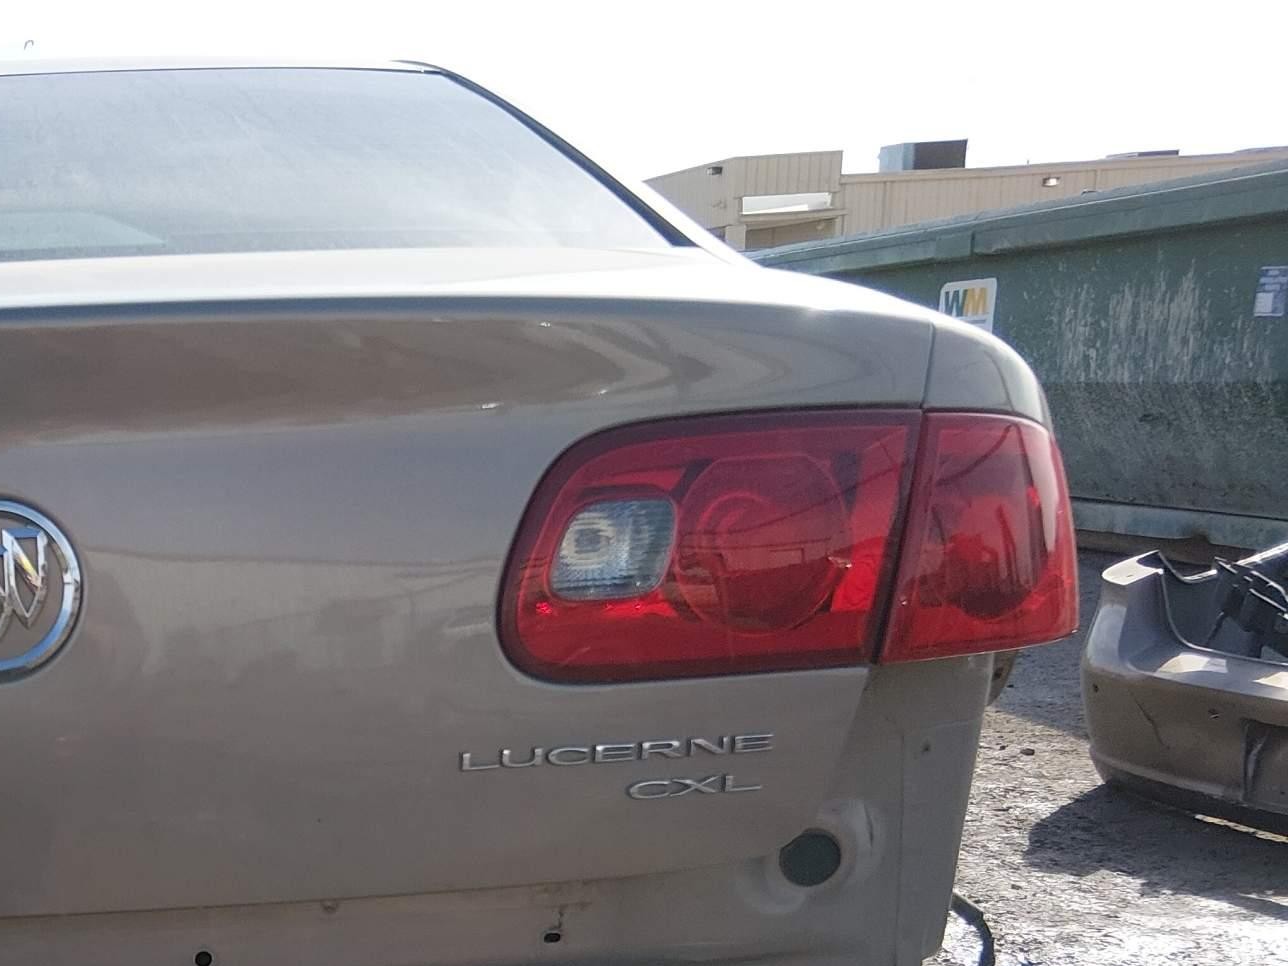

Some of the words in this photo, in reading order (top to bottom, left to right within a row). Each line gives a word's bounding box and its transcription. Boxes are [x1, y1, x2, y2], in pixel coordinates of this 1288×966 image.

[943, 287, 988, 317] WM
[459, 733, 775, 772] LUCERNE
[627, 774, 762, 800] CXL
